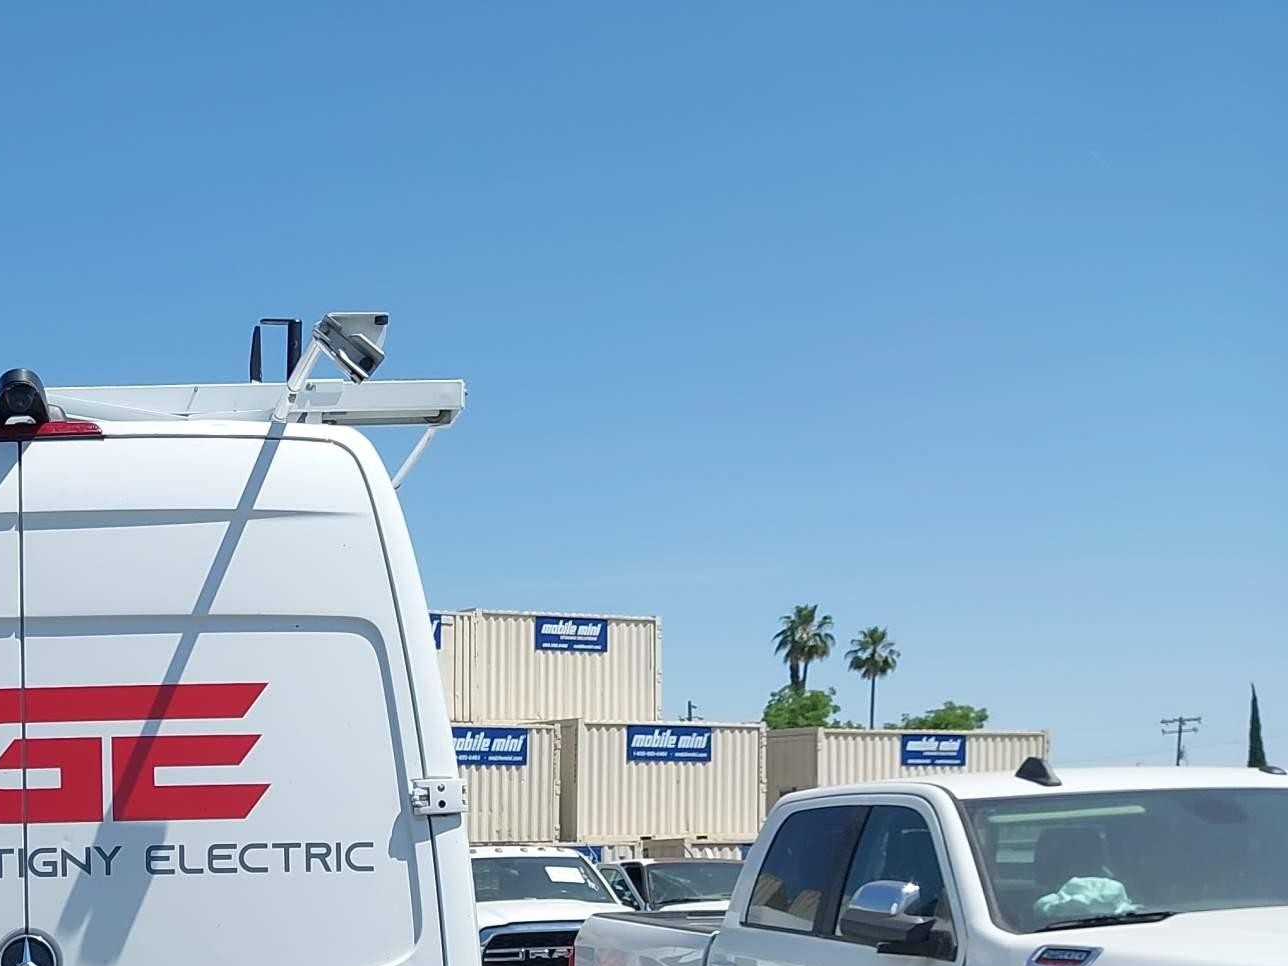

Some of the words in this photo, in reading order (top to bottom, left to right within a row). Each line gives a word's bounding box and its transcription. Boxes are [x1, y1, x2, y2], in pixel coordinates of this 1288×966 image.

[541, 619, 578, 635] mobile
[577, 622, 602, 637] mini
[490, 734, 524, 752] mini
[631, 728, 678, 748] mobile
[677, 732, 709, 749] mini
[145, 841, 376, 876] ELECTRIC
